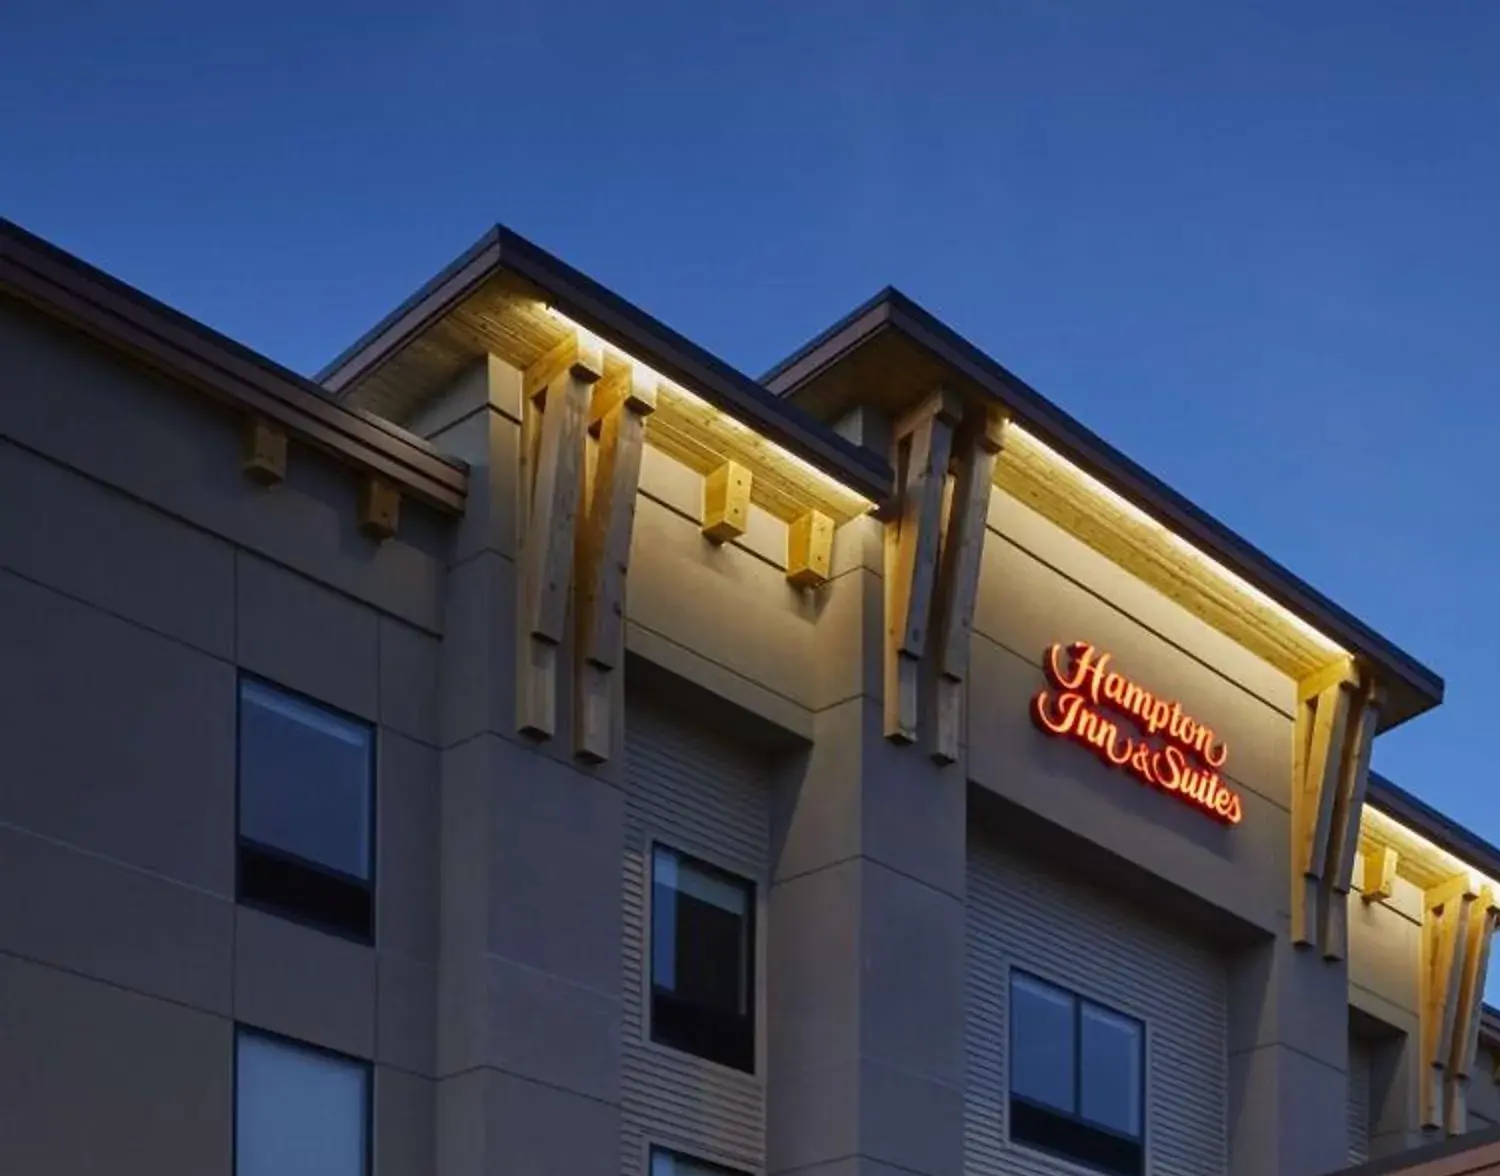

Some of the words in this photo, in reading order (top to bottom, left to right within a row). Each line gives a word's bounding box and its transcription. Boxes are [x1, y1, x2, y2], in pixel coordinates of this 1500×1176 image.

[1033, 690, 1133, 765] Inn
[1132, 742, 1155, 783] &
[1152, 745, 1242, 823] Suites
[1045, 641, 1228, 767] Hampton
